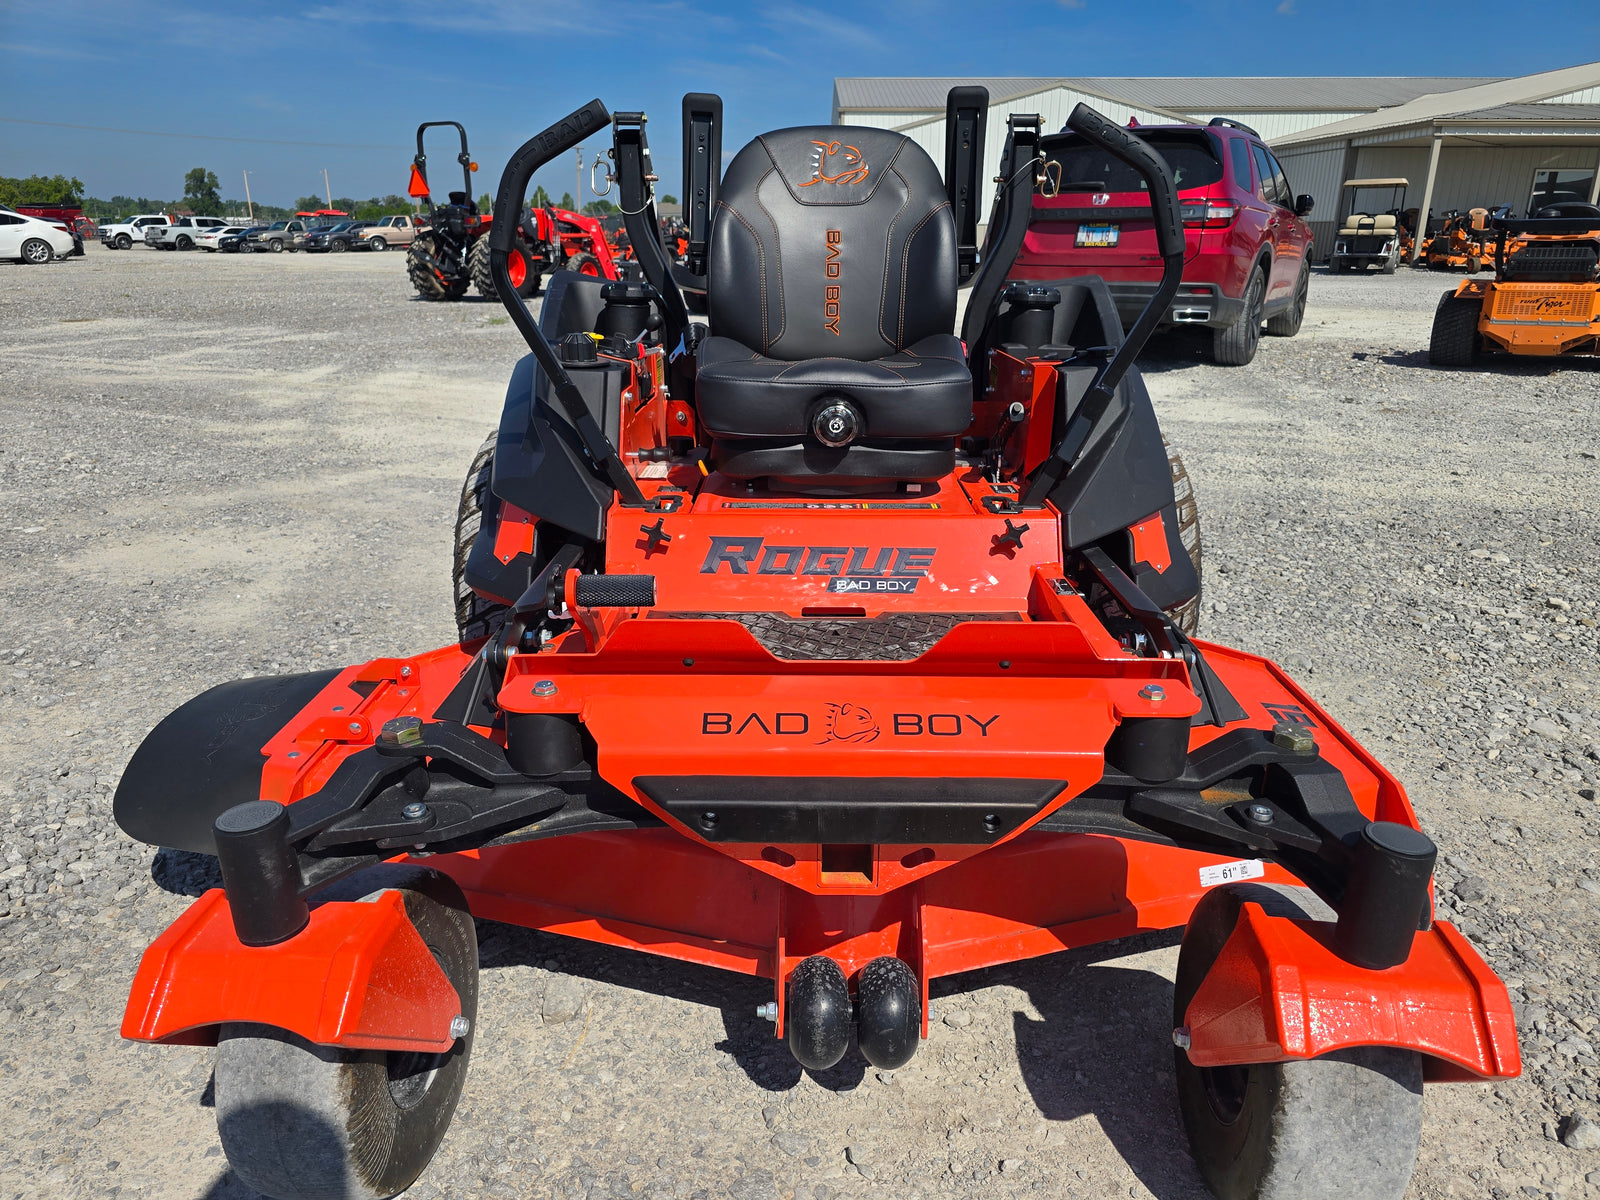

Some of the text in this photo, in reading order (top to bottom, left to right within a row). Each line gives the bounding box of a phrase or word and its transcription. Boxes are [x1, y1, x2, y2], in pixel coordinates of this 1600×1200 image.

[538, 109, 594, 153] BAD
[1081, 112, 1141, 150] BOY
[824, 229, 843, 336] BAD BOY
[835, 580, 912, 591] BAD BOY
[701, 712, 1001, 737] BAD BOY
[1222, 866, 1237, 880] 61"
